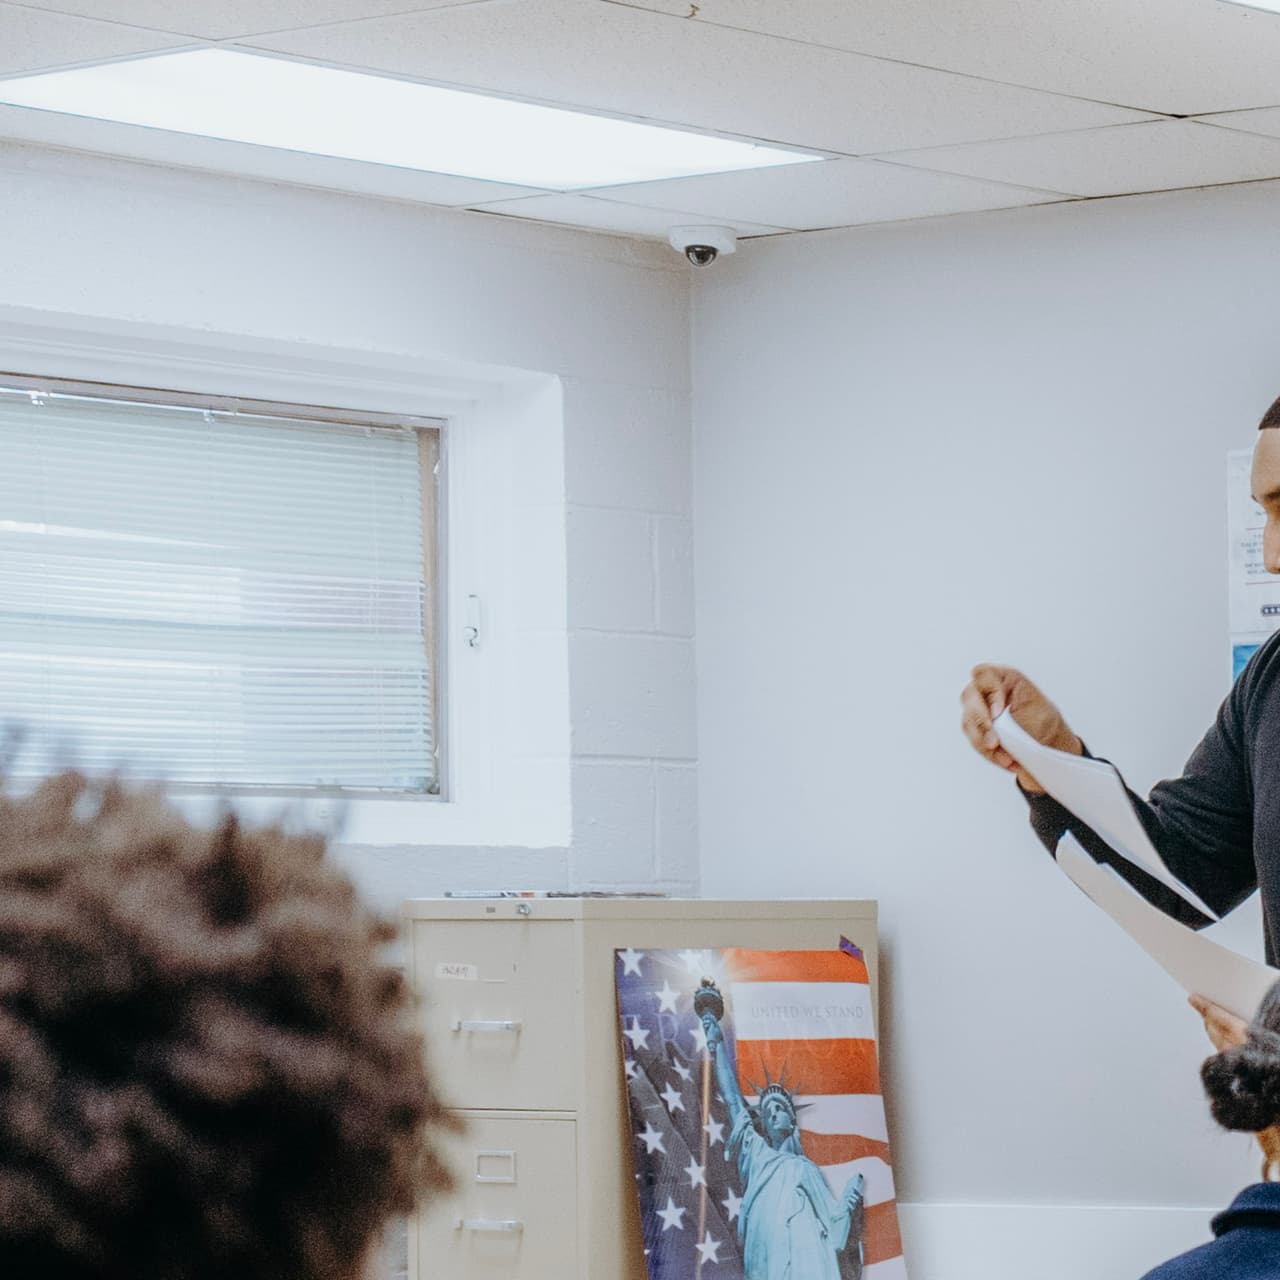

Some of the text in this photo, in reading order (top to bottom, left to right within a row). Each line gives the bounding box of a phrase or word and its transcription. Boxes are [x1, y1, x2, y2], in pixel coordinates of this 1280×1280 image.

[751, 1004, 866, 1019] UNITED WE STAND
